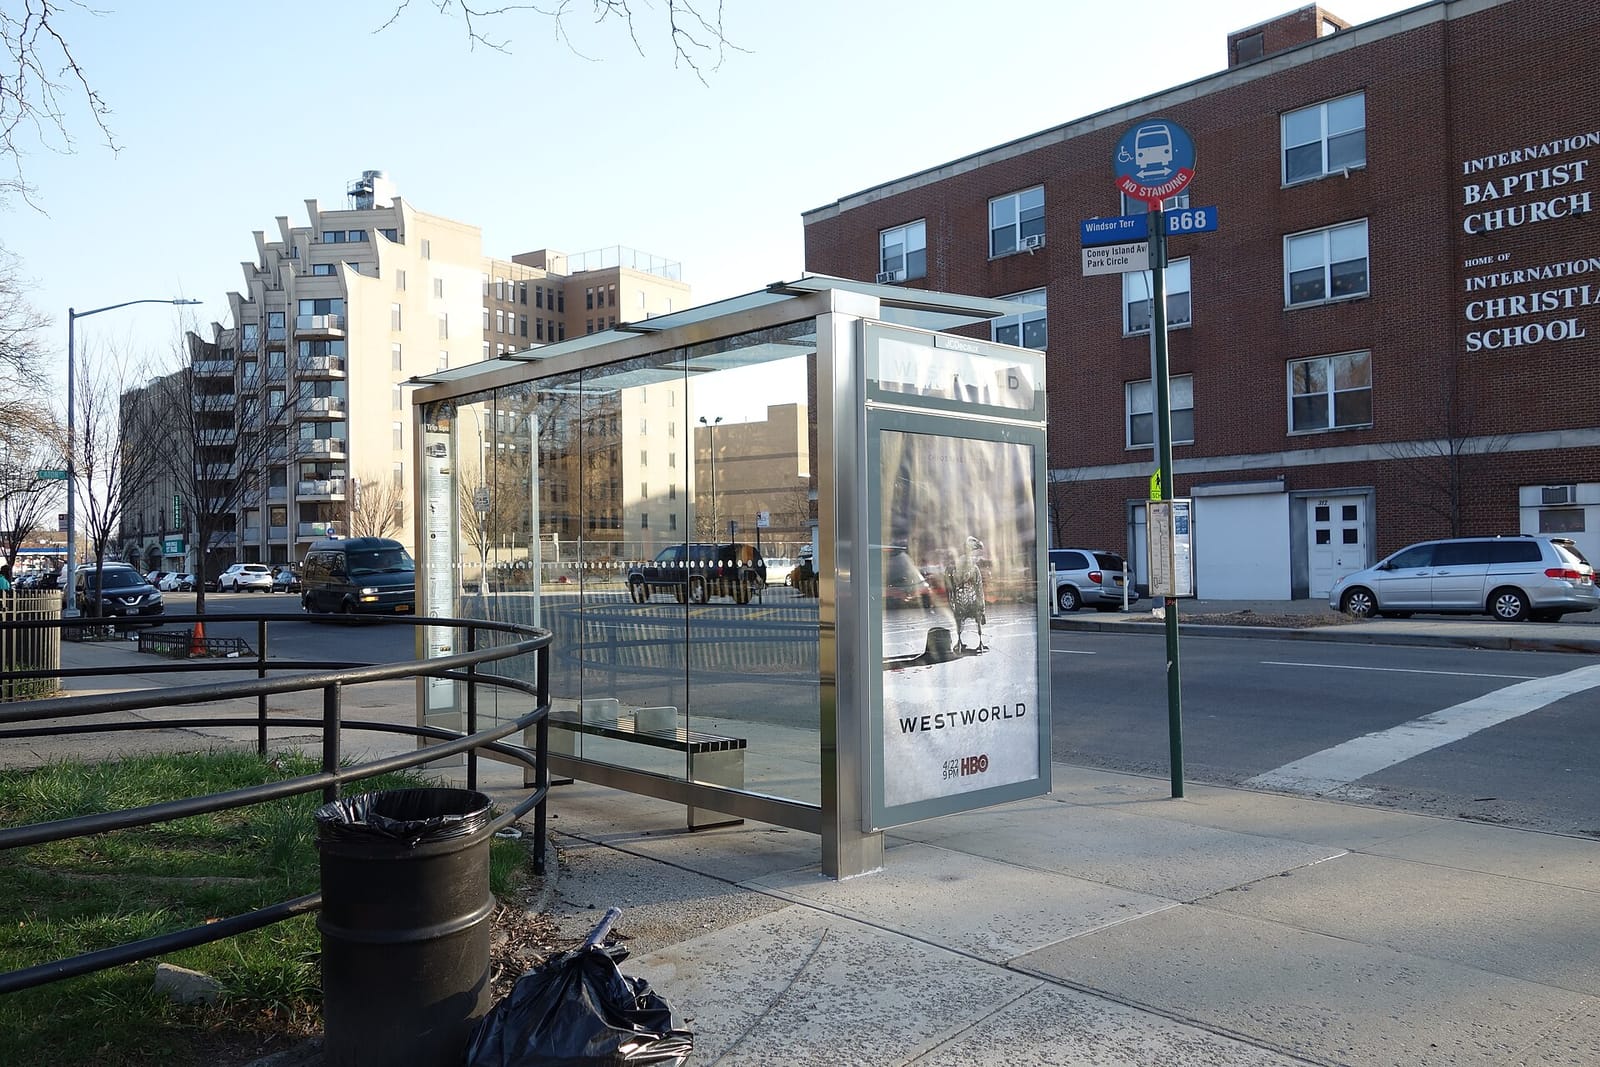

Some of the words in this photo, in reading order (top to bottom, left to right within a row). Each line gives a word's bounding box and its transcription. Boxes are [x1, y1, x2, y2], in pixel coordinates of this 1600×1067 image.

[1122, 179, 1137, 194] NO
[1139, 172, 1187, 198] STANDING
[1463, 160, 1589, 206] BAPTIST
[1170, 210, 1207, 232] B68
[1463, 191, 1592, 235] CHURCH
[1085, 222, 1117, 233] Windsor
[1119, 219, 1135, 229] Terr
[1087, 249, 1110, 258] Coney
[1112, 245, 1135, 255] Island
[1136, 244, 1147, 254] Av
[1465, 258, 1494, 268] HOME
[1497, 252, 1511, 262] OF
[1087, 259, 1105, 268] Park
[1106, 257, 1129, 266] Circle
[1466, 318, 1586, 352] SCHOOL
[900, 703, 1026, 733] WESTWORLD
[942, 759, 959, 770] 4/22
[960, 754, 989, 777] HBO
